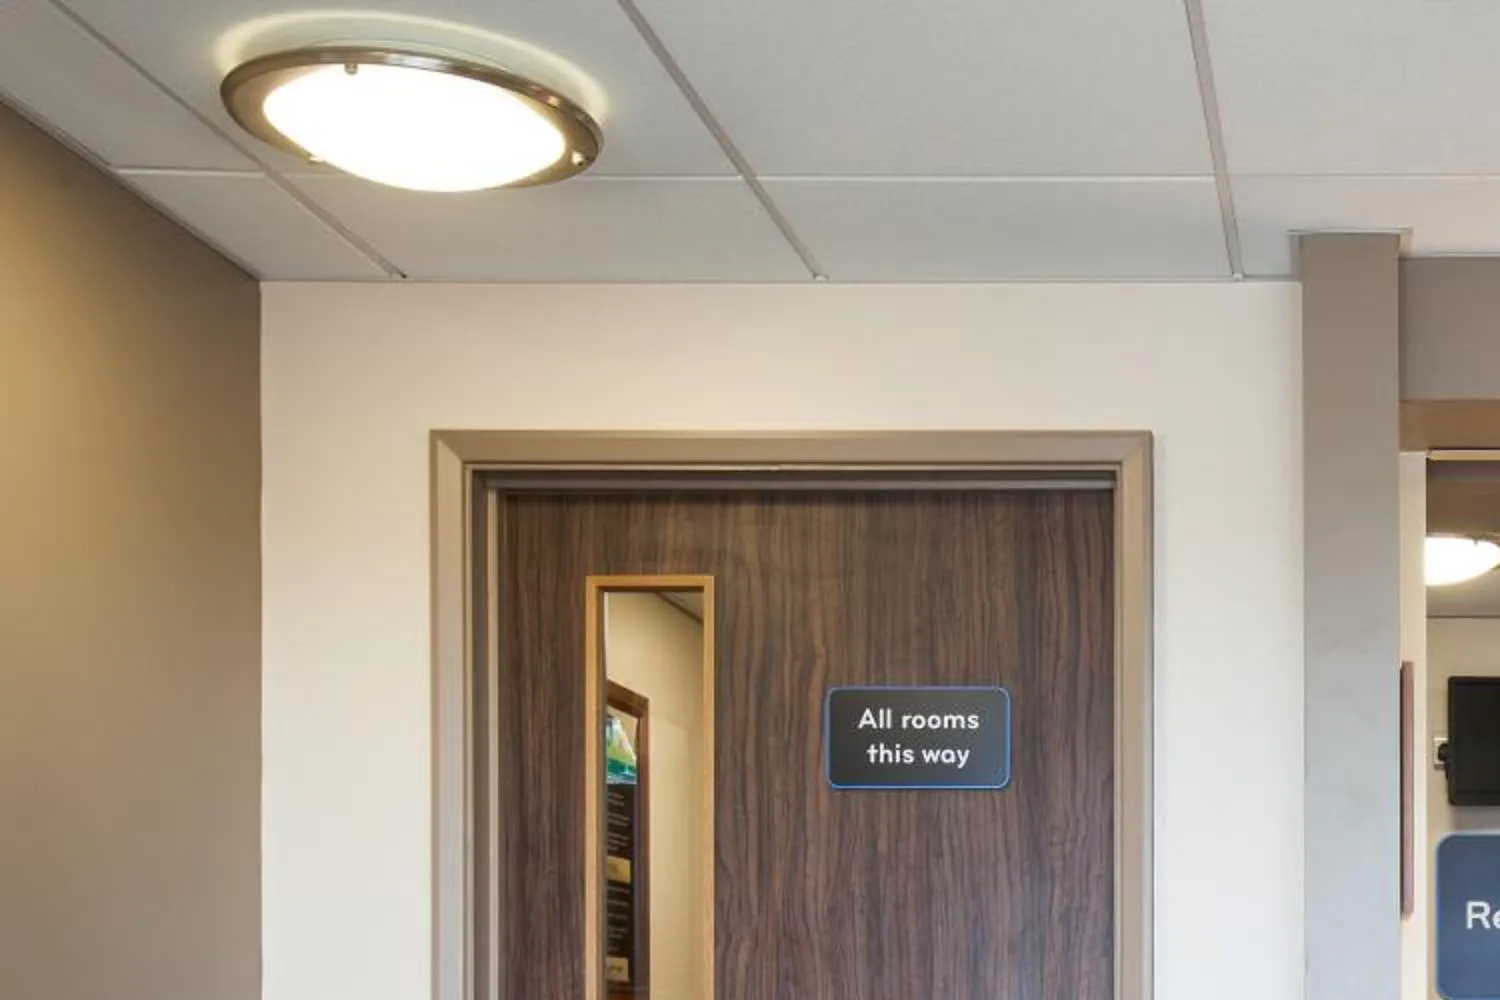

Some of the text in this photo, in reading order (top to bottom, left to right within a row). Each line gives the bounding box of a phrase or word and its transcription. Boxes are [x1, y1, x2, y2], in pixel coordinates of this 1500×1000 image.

[858, 708, 980, 730] All rooms
[866, 743, 970, 769] this way
